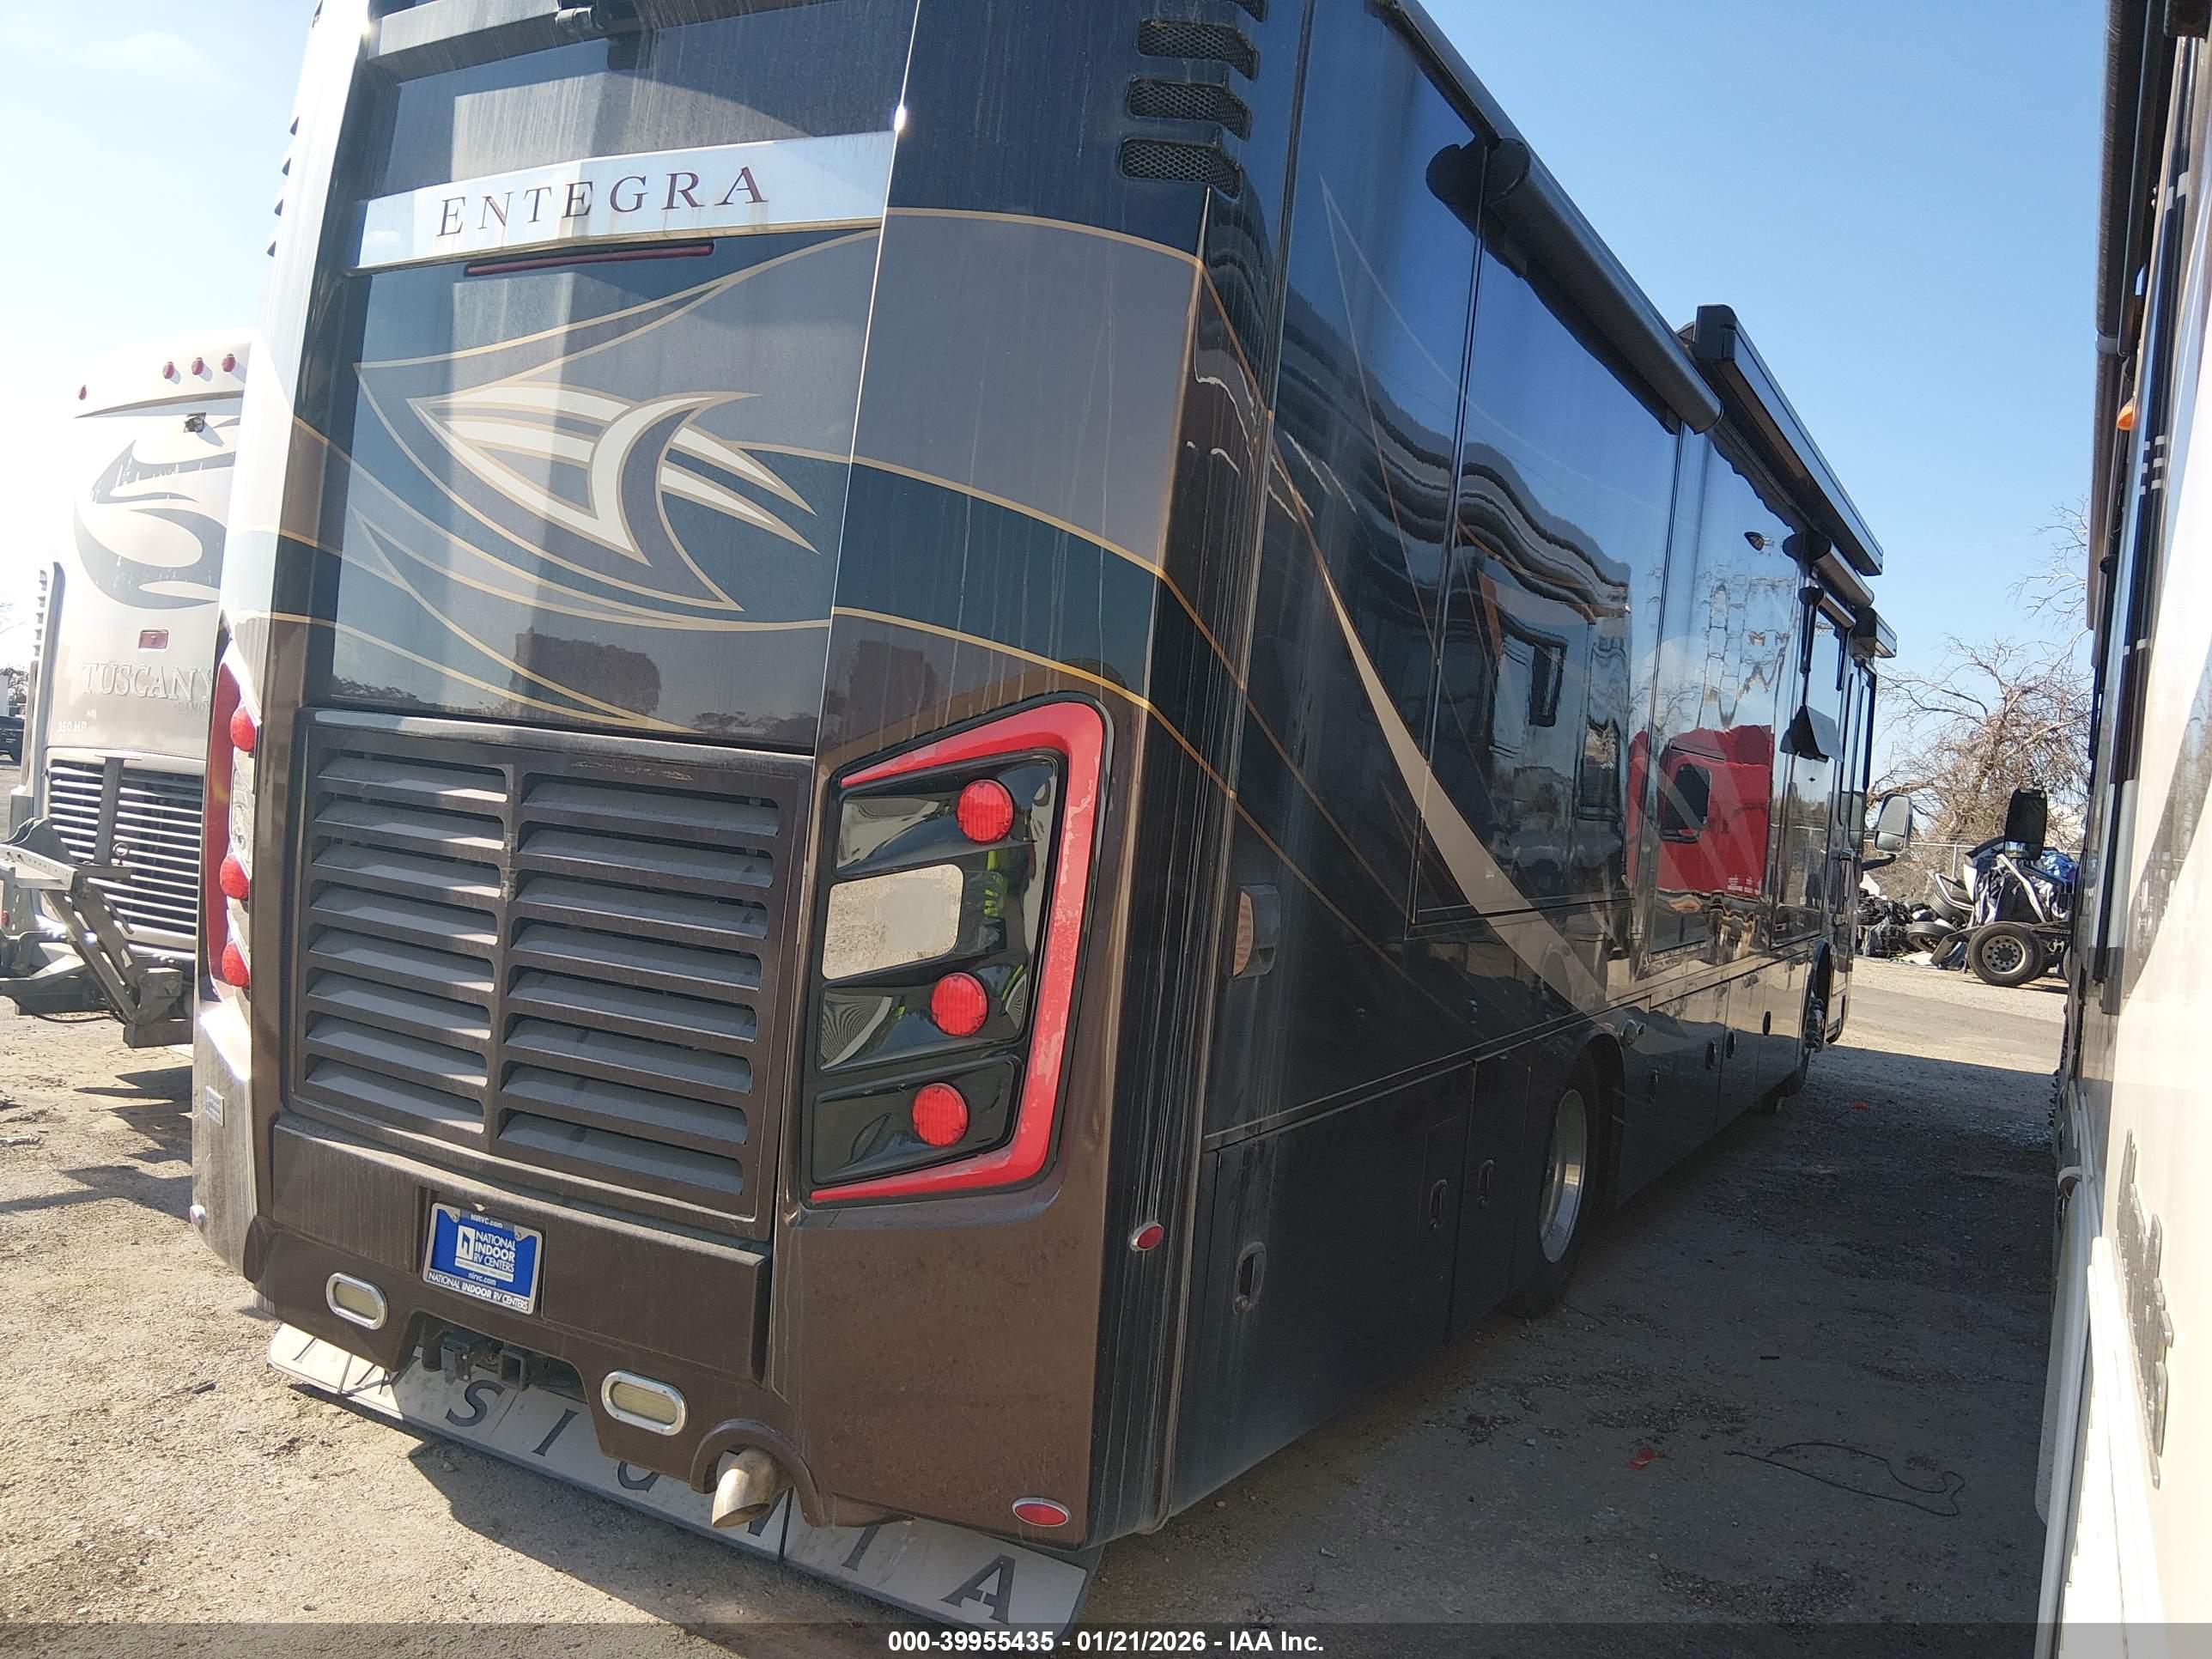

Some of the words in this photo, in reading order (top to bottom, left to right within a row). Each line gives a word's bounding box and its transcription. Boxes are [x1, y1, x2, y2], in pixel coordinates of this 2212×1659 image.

[436, 164, 769, 237] ENTEGRA
[82, 660, 212, 702] TUSCANY
[178, 701, 210, 717] DAMO
[74, 720, 88, 732] HP
[471, 1213, 503, 1229] NIRVC.com
[476, 1230, 516, 1251] NATIONAL
[473, 1252, 483, 1263] RV
[483, 1255, 515, 1273] CENTERS
[475, 1242, 515, 1263] INDOOR
[468, 1272, 497, 1286] nirvc.com
[428, 1272, 460, 1289] NATIONAL
[461, 1281, 492, 1299] INDOOR
[493, 1291, 502, 1302] RV
[502, 1294, 528, 1310] CENTERS
